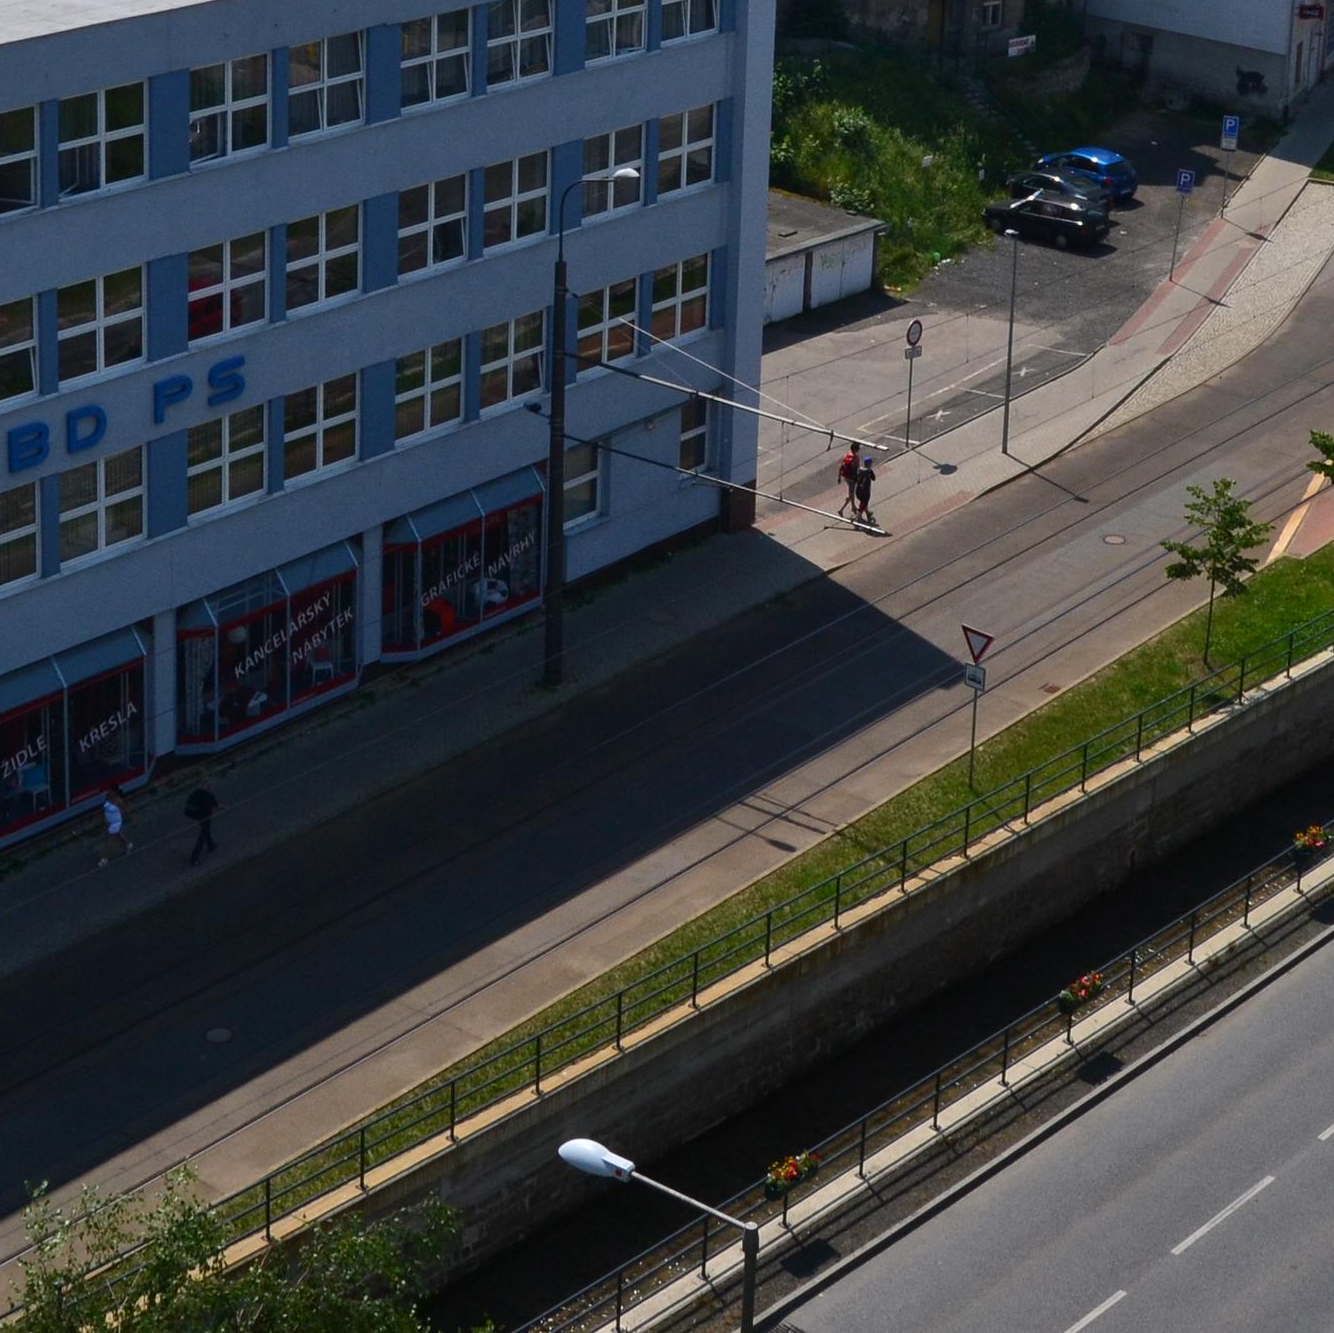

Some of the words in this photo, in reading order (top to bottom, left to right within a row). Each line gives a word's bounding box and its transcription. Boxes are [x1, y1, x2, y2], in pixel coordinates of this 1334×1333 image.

[1225, 118, 1236, 131] P
[1179, 172, 1191, 186] P
[153, 355, 245, 425] PS
[420, 551, 482, 607] GRAFICKÉ
[0, 734, 47, 779] ŽIDLE
[79, 702, 138, 753] KŘESLA
